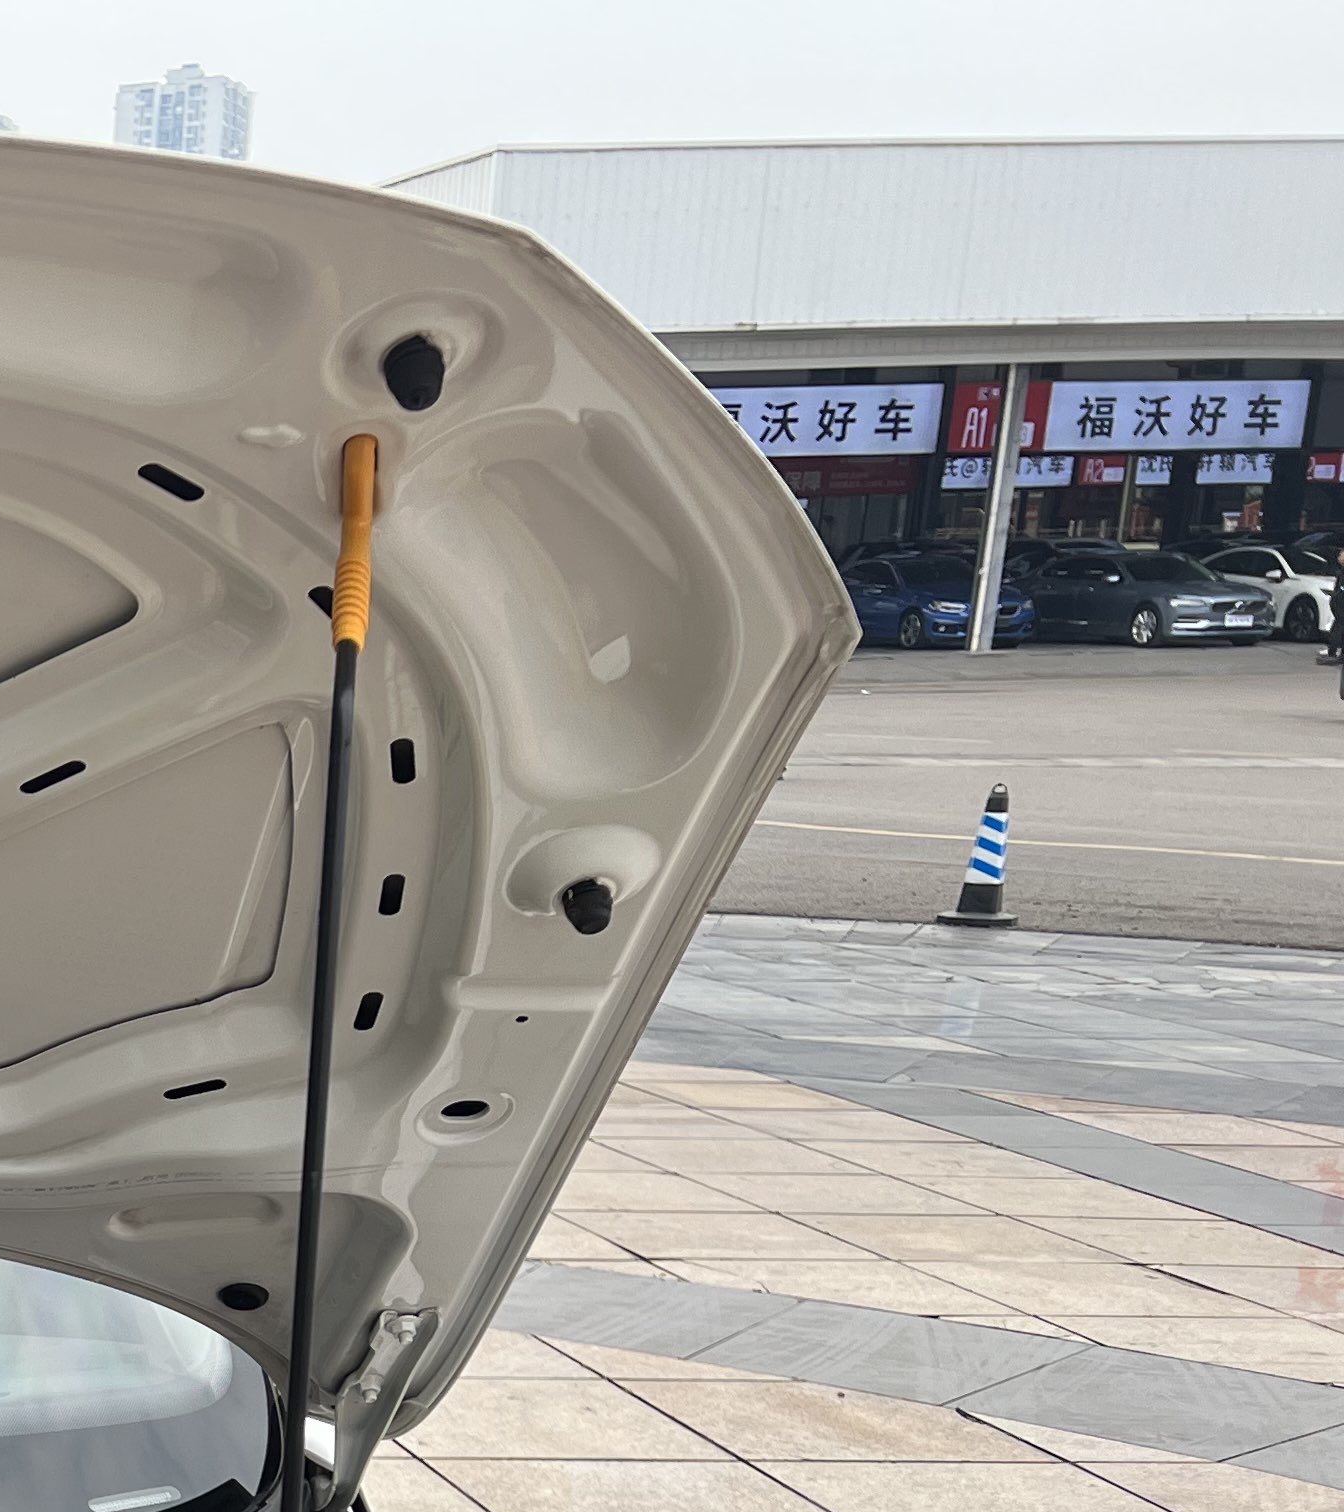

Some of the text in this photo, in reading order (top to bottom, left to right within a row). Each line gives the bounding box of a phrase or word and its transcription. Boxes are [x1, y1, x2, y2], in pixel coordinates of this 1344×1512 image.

[961, 406, 989, 449] A1
[1077, 394, 1282, 438] 福沃好车
